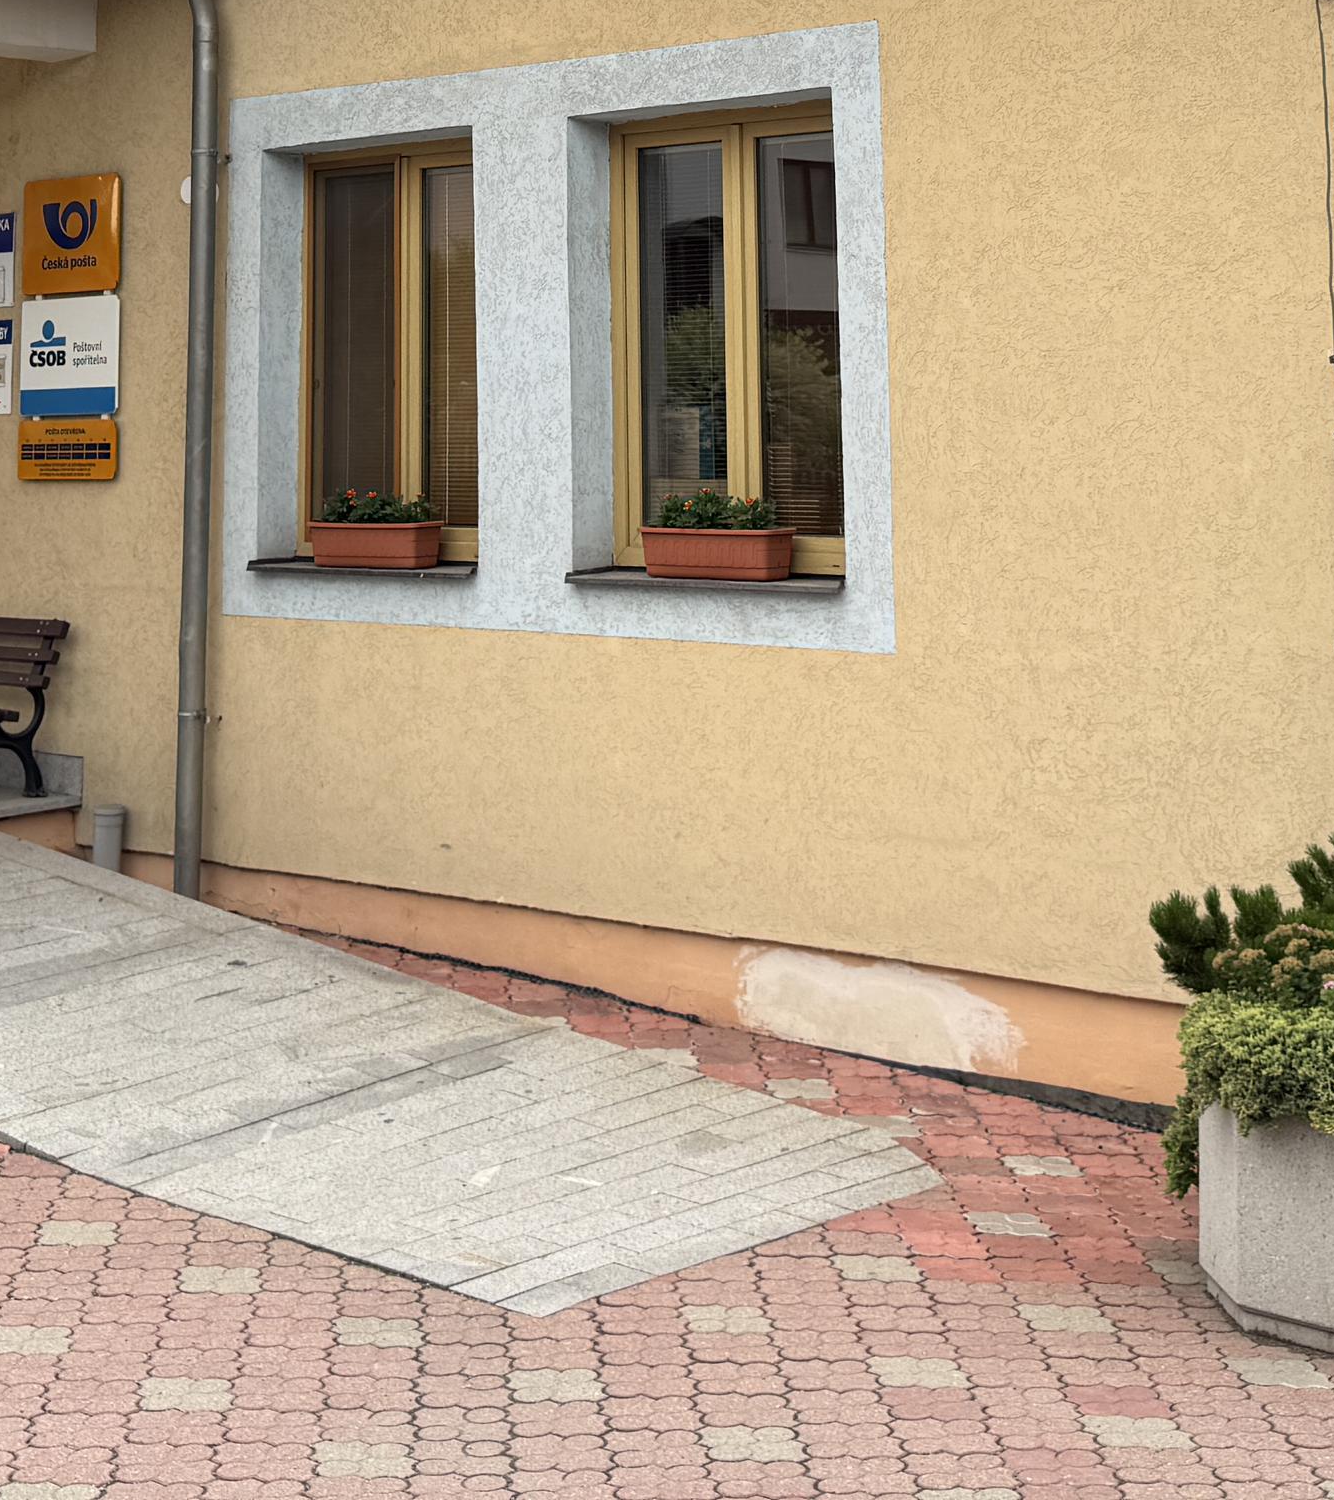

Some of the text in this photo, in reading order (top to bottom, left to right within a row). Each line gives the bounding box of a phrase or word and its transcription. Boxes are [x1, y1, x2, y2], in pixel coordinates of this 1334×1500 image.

[42, 255, 97, 270] Česká pošta
[73, 341, 102, 352] Poštovní
[29, 350, 66, 367] ČSOB
[73, 355, 107, 368] spořitelna
